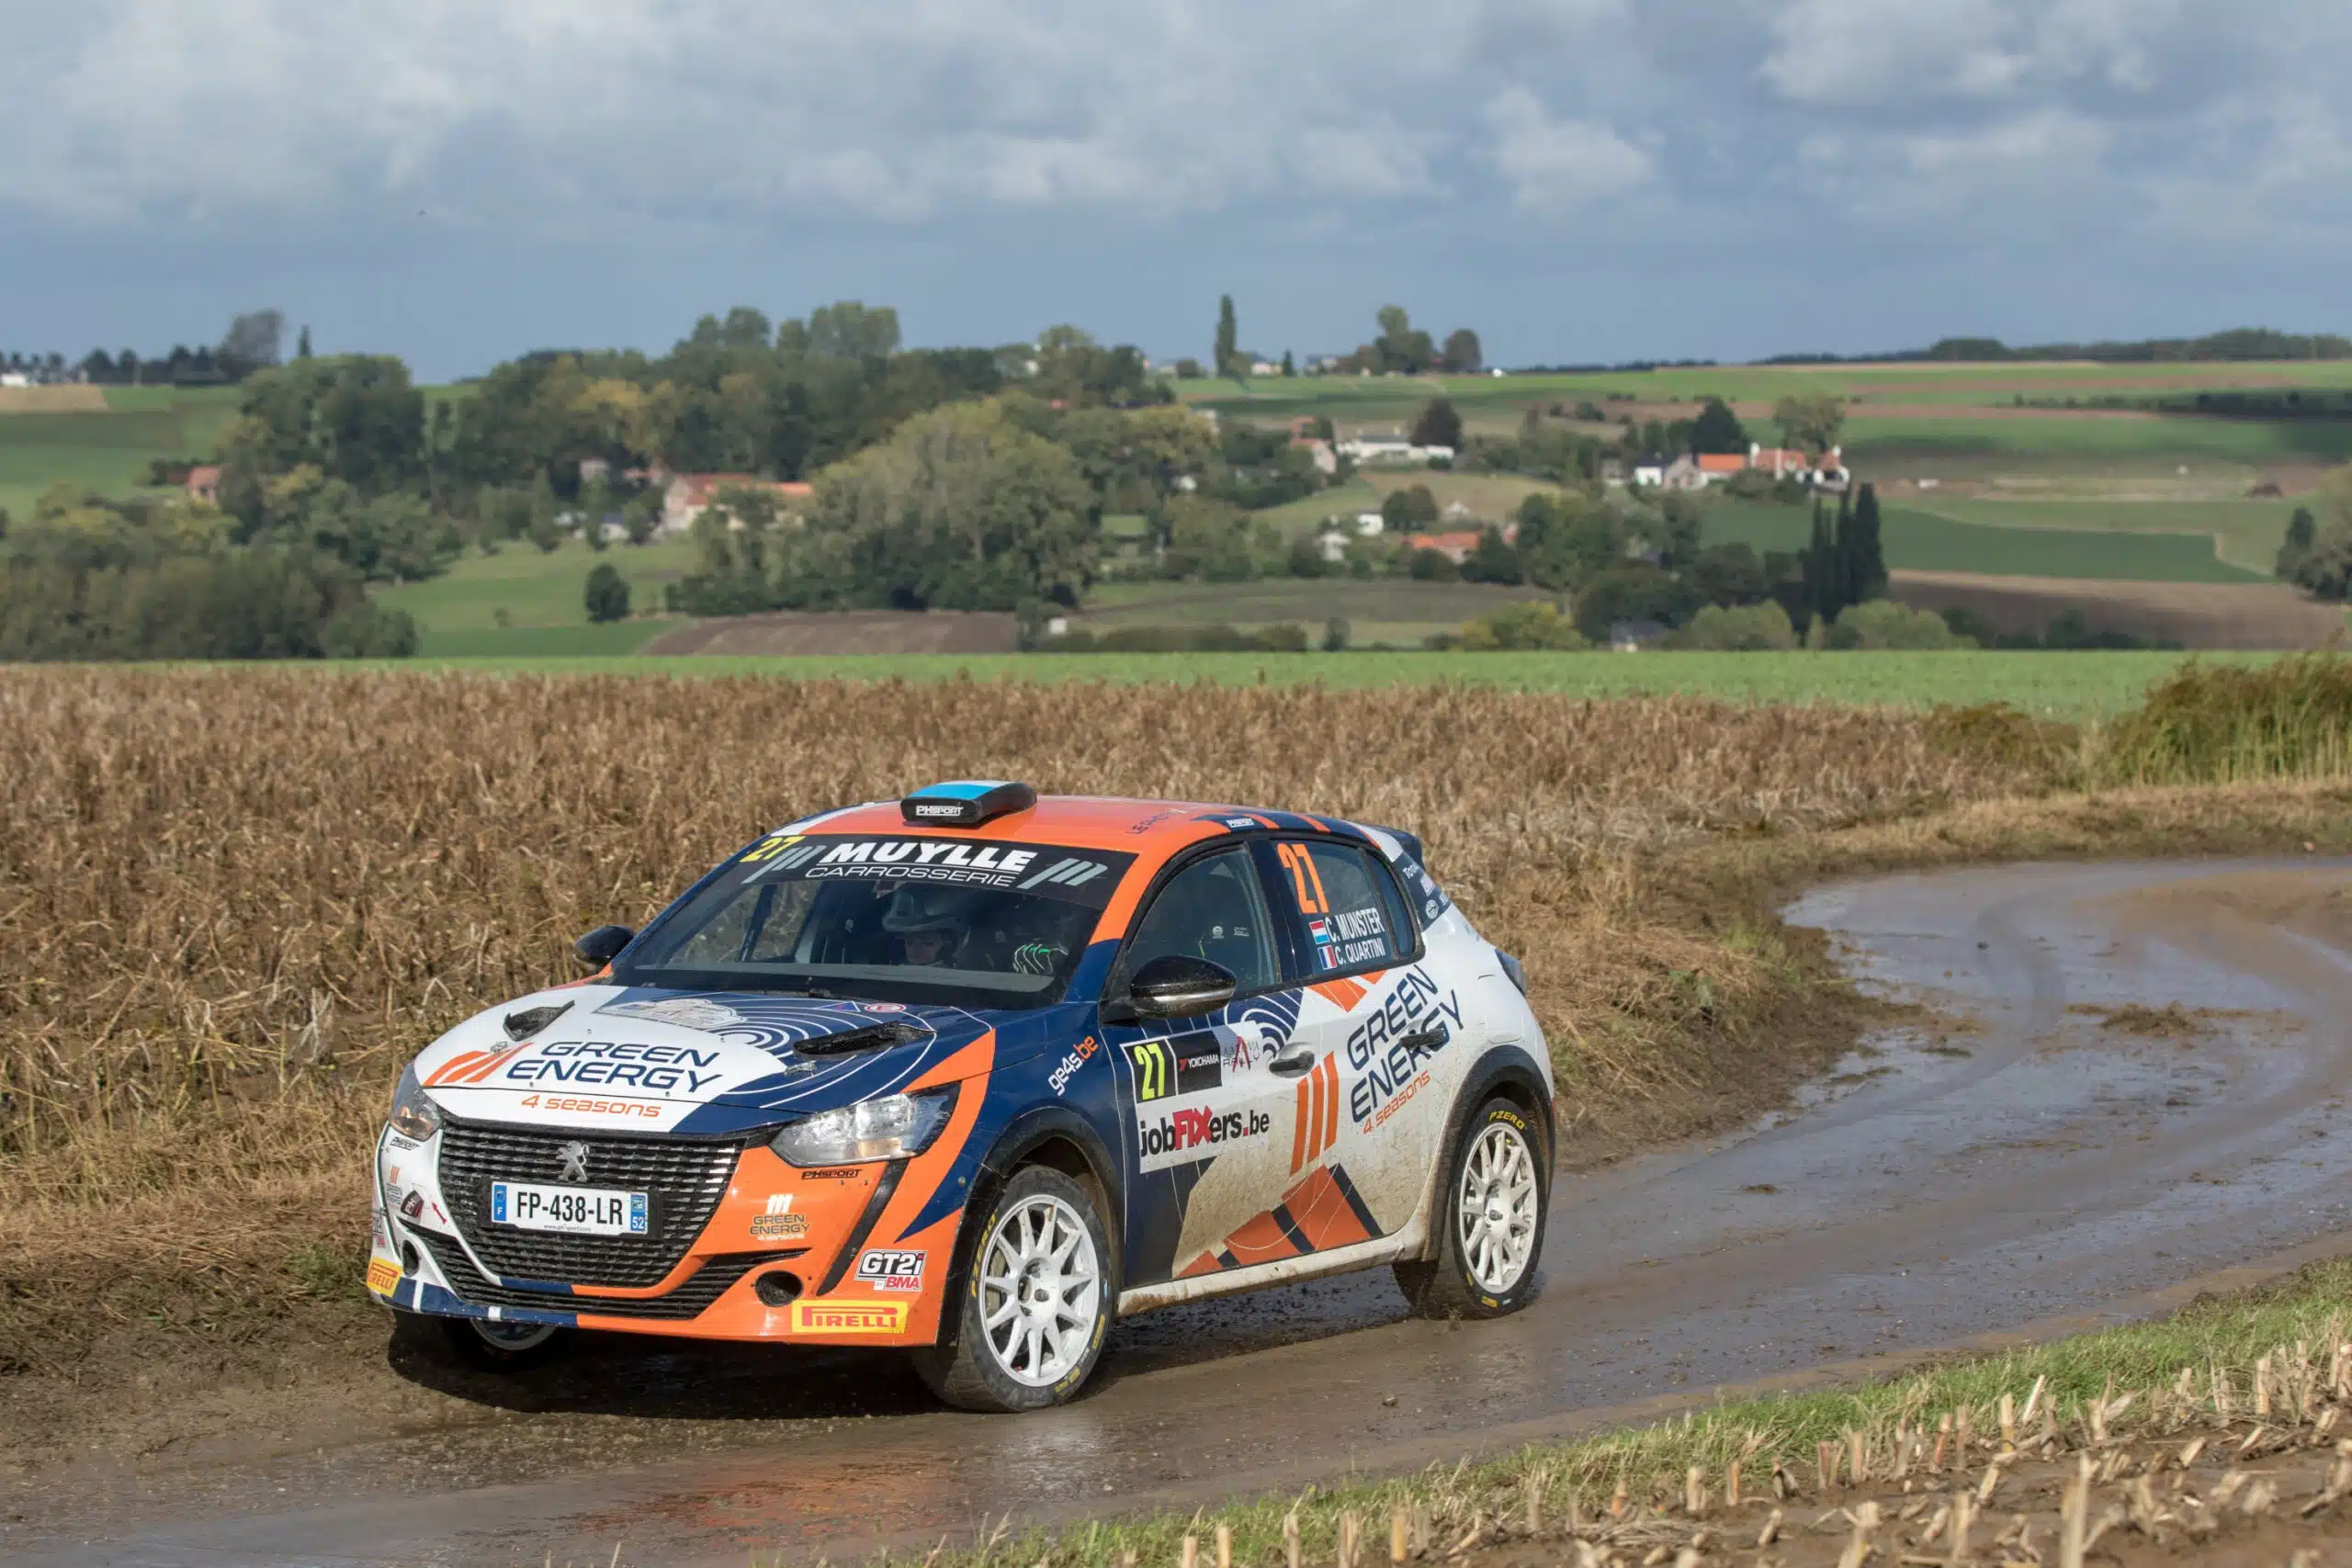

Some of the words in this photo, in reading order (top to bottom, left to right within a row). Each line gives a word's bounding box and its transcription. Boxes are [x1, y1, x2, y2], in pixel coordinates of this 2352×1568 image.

[739, 836, 805, 863] 27
[818, 840, 1036, 873] MUYLLE
[805, 865, 1018, 888] CARROSSERIE
[1277, 843, 1329, 914] 27
[1325, 916, 1340, 942] C.
[1335, 908, 1385, 941] MUNSTER
[1335, 945, 1347, 965] C.
[1345, 938, 1386, 964] QUARTINI
[1347, 964, 1438, 1071] GREEN
[540, 1040, 720, 1067] GREEN
[1047, 1035, 1100, 1097] ge4s.be
[1188, 1054, 1219, 1069] YOKOHAMA
[506, 1059, 723, 1093] ENERGY
[1133, 1043, 1165, 1100] 27
[521, 1094, 538, 1109] 4
[545, 1097, 662, 1118] seasons
[1363, 1118, 1372, 1134] 4
[1375, 1069, 1431, 1127] seasons
[1140, 1105, 1270, 1157] jobFIXers.be
[497, 1207, 503, 1216] F
[516, 1191, 623, 1225] FP-438-LR
[753, 1213, 806, 1225] GREEN
[632, 1215, 644, 1230] 52
[750, 1223, 810, 1235] ENERGY
[861, 1251, 925, 1275] GT2i
[886, 1277, 920, 1289] BMA
[801, 1306, 898, 1328] PIRELLI
